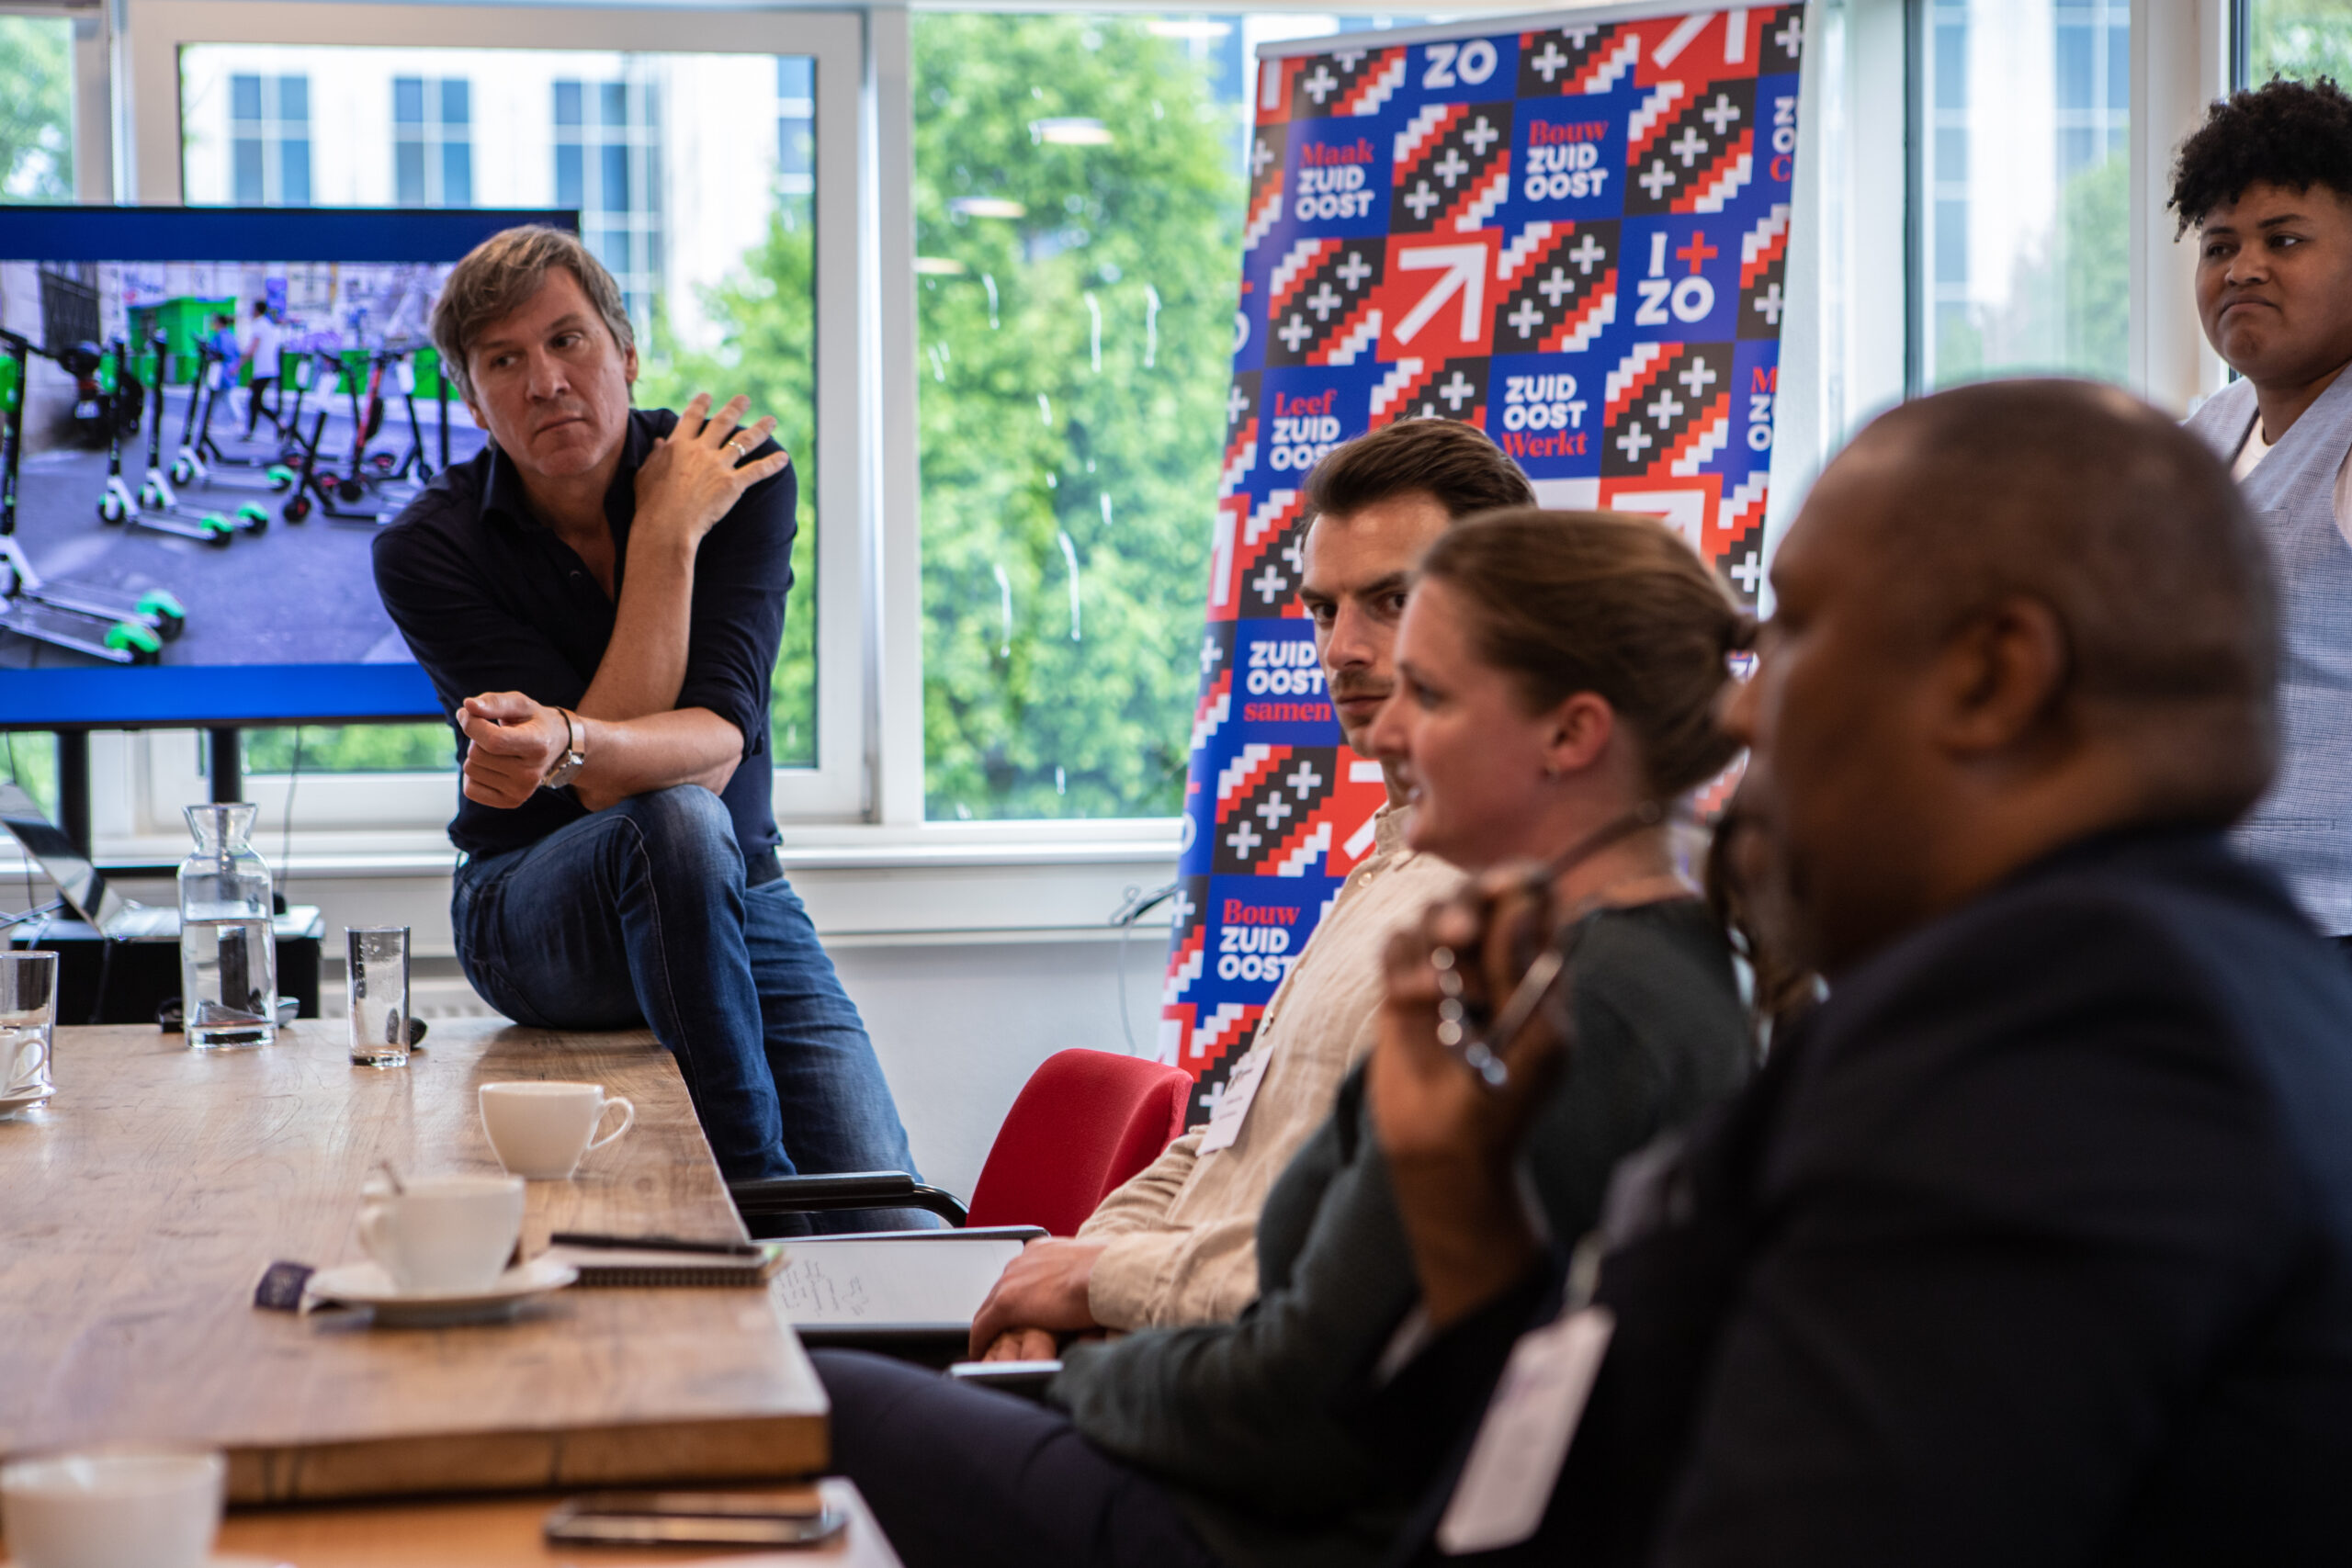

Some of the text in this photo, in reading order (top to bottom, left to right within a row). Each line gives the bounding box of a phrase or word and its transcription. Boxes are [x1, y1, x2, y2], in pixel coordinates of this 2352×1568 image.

[1422, 39, 1498, 89] ZO
[1529, 119, 1609, 146] Bouw
[1299, 138, 1374, 168] Maak
[1526, 142, 1598, 175] ZUID
[1296, 164, 1365, 196] ZUID
[1524, 167, 1609, 201] OOST
[1295, 189, 1375, 221] OOST
[1634, 276, 1715, 325] ZO
[1274, 389, 1338, 417] Leef
[1505, 374, 1577, 404] ZUID
[1271, 415, 1340, 444] ZUID
[1503, 400, 1588, 432] OOST
[1501, 429, 1588, 457] Werkt
[1248, 640, 1317, 669] ZUID
[1246, 668, 1325, 695] OOST
[1244, 702, 1332, 722] samen
[1222, 898, 1301, 926] Bouw
[1219, 926, 1290, 953] ZUID
